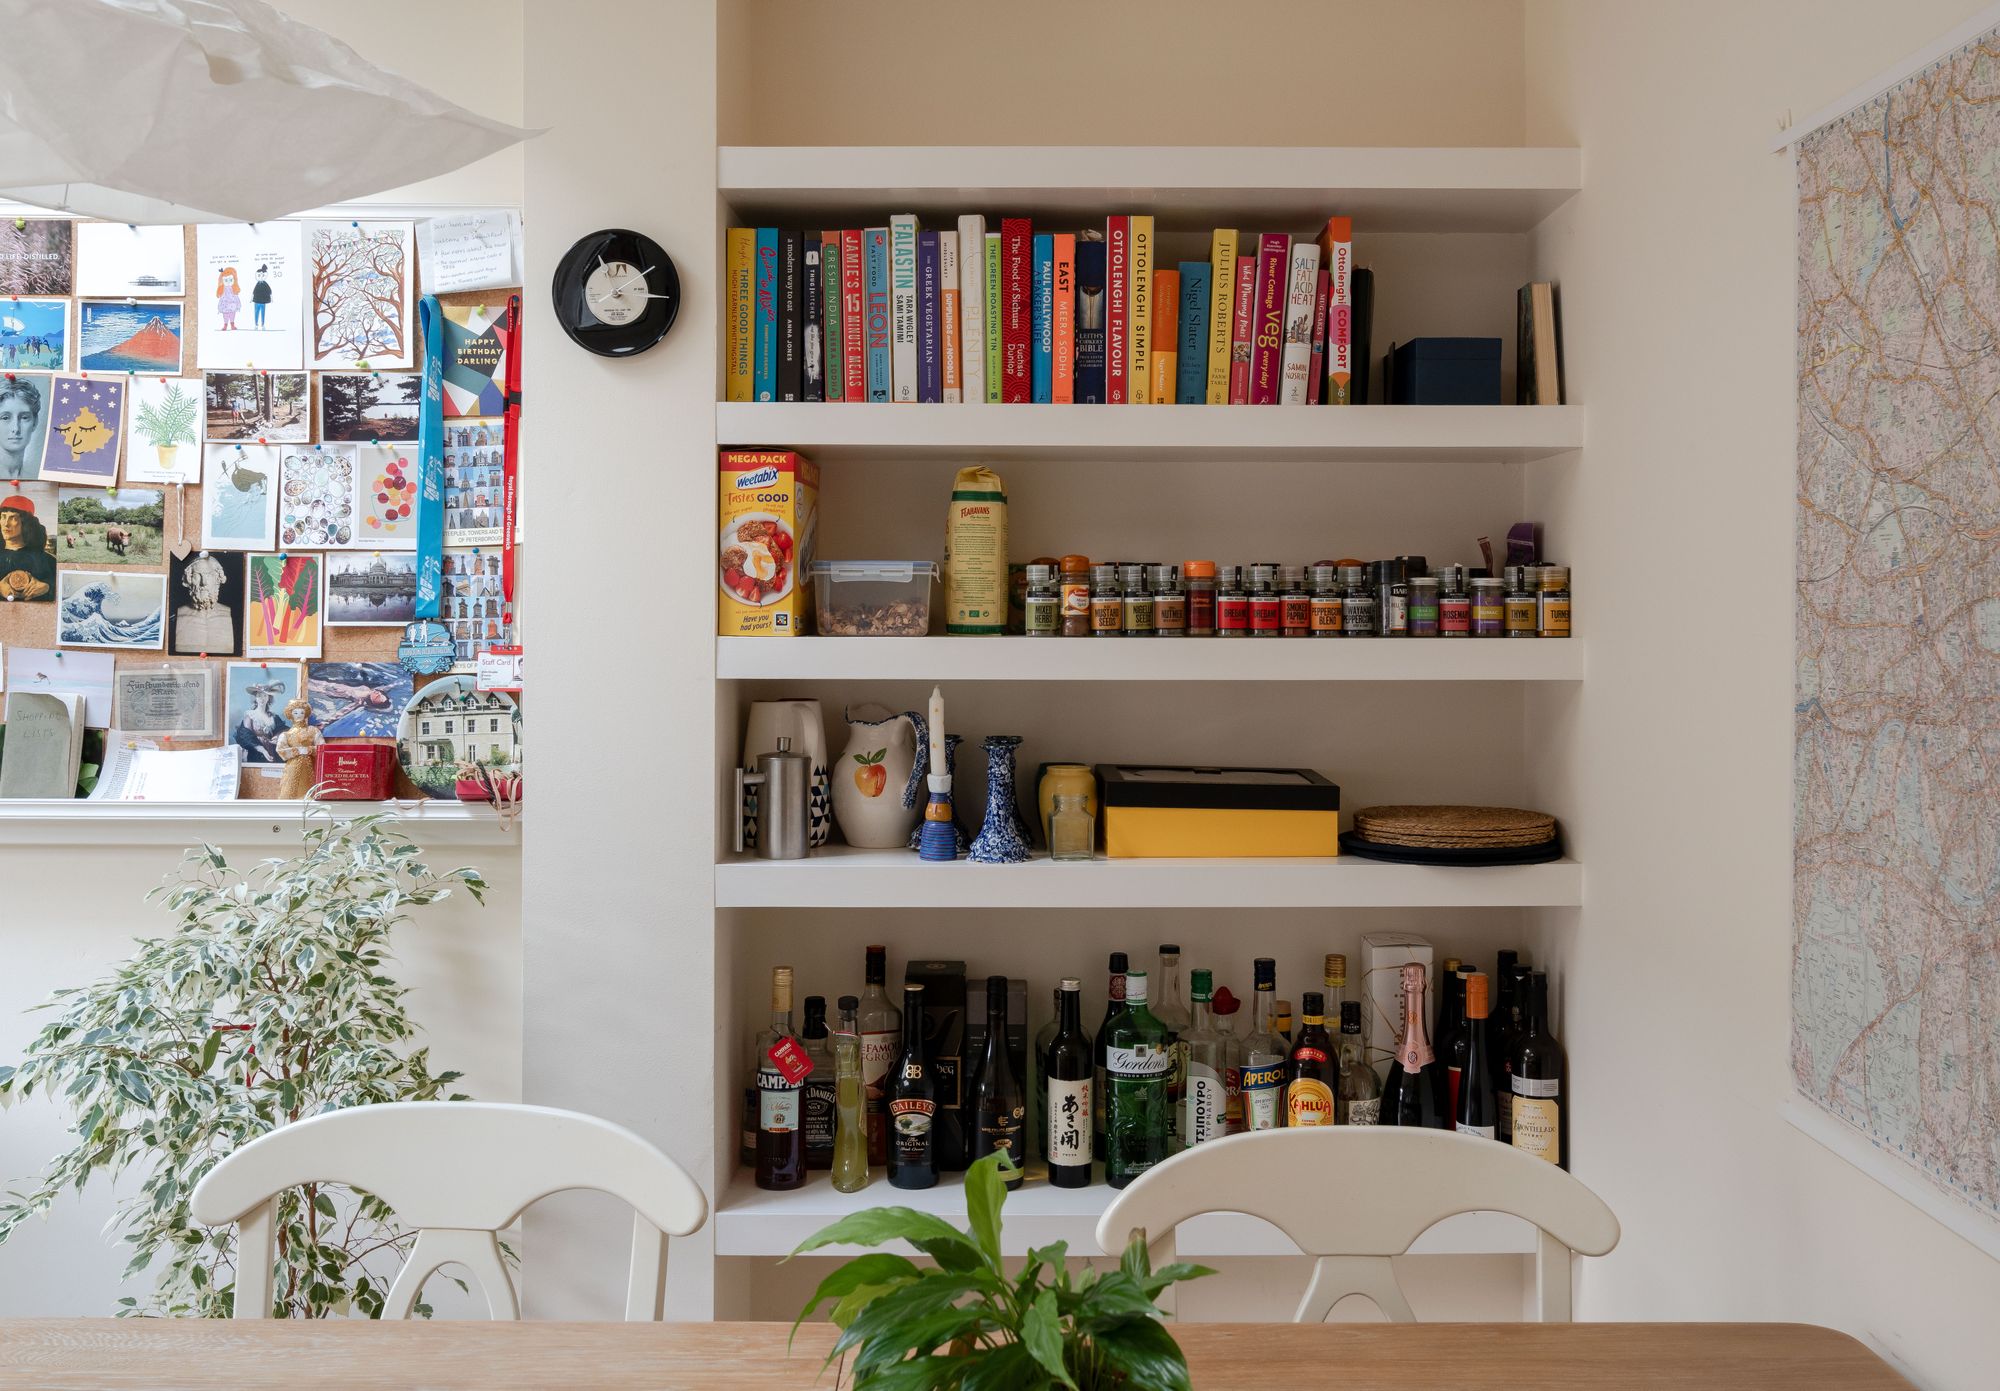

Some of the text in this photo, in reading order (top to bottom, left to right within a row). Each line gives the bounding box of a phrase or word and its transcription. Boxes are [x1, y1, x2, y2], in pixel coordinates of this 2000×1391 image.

[828, 250, 836, 286] FRESH
[895, 224, 913, 289] FALASTIN
[1295, 257, 1316, 269] SALT
[1012, 236, 1021, 329] The Food of Sichuan
[1296, 270, 1313, 280] FAT
[787, 291, 793, 299] to
[1216, 242, 1230, 354] JULIUS ROBERTS
[1294, 282, 1313, 293] ACID
[828, 290, 836, 326] INDIA
[1033, 278, 1042, 322] BAKER'S
[1042, 261, 1051, 353] PAUL HOLLYWOOD
[1112, 230, 1123, 377] OTTOLENGHI FLAVOUR
[1135, 233, 1146, 372] OTTOLENGHI SIMPLE
[1237, 283, 1253, 319] Mummy
[1291, 294, 1314, 305] HEAT
[1336, 248, 1348, 369] Ottolenghi COMFORT
[739, 268, 749, 376] THREE GOOD THINGS
[846, 236, 860, 387] JAMIE'S 15 MINUTE MEALS
[869, 292, 888, 349] LEON
[925, 266, 933, 364] GREEK VEGETARIAN
[945, 293, 953, 334] DUMPLINGS
[1059, 262, 1069, 379] EAST MEERA SODHA
[1185, 278, 1202, 350] Nigel Slater
[1258, 257, 1280, 389] River Cottage veg everyday!
[906, 315, 914, 344] WIGLEY
[1033, 324, 1042, 344] LIFE
[1316, 312, 1325, 336] CAKES
[464, 338, 495, 346] HAPPY
[966, 306, 980, 379] PLENTY
[946, 347, 954, 384] NOODLES
[1007, 344, 1015, 375] Dunlop
[1017, 344, 1025, 377] Fuchsia
[1287, 363, 1307, 372] SAMIN
[1285, 372, 1308, 380] NOSRAT
[729, 455, 786, 463] MEGA PACK
[506, 475, 514, 491] Royal
[736, 466, 779, 488] Weetabix
[506, 492, 514, 514] Borough
[728, 492, 789, 505] Tastes GOOD
[505, 522, 513, 550] Greenwich
[743, 615, 769, 625] Have you
[1035, 606, 1052, 614] MIXED
[1035, 615, 1052, 623] HERBS
[1094, 608, 1119, 617] MUSTARD
[1319, 616, 1336, 625] BLEND
[1511, 609, 1529, 619] THYME
[740, 620, 772, 631] had yours?
[1099, 618, 1116, 626] SEEDS
[774, 1042, 792, 1058] CAMPARI
[1112, 1050, 1165, 1071] Gordon's
[1297, 1051, 1323, 1059] IMPORTED
[1243, 1070, 1286, 1086] APEROL
[892, 1102, 934, 1113] BAILEYS
[1196, 1081, 1206, 1143] ΤΣΙΠΟΥΡΟ
[1289, 1093, 1331, 1116] KAHLÚA
